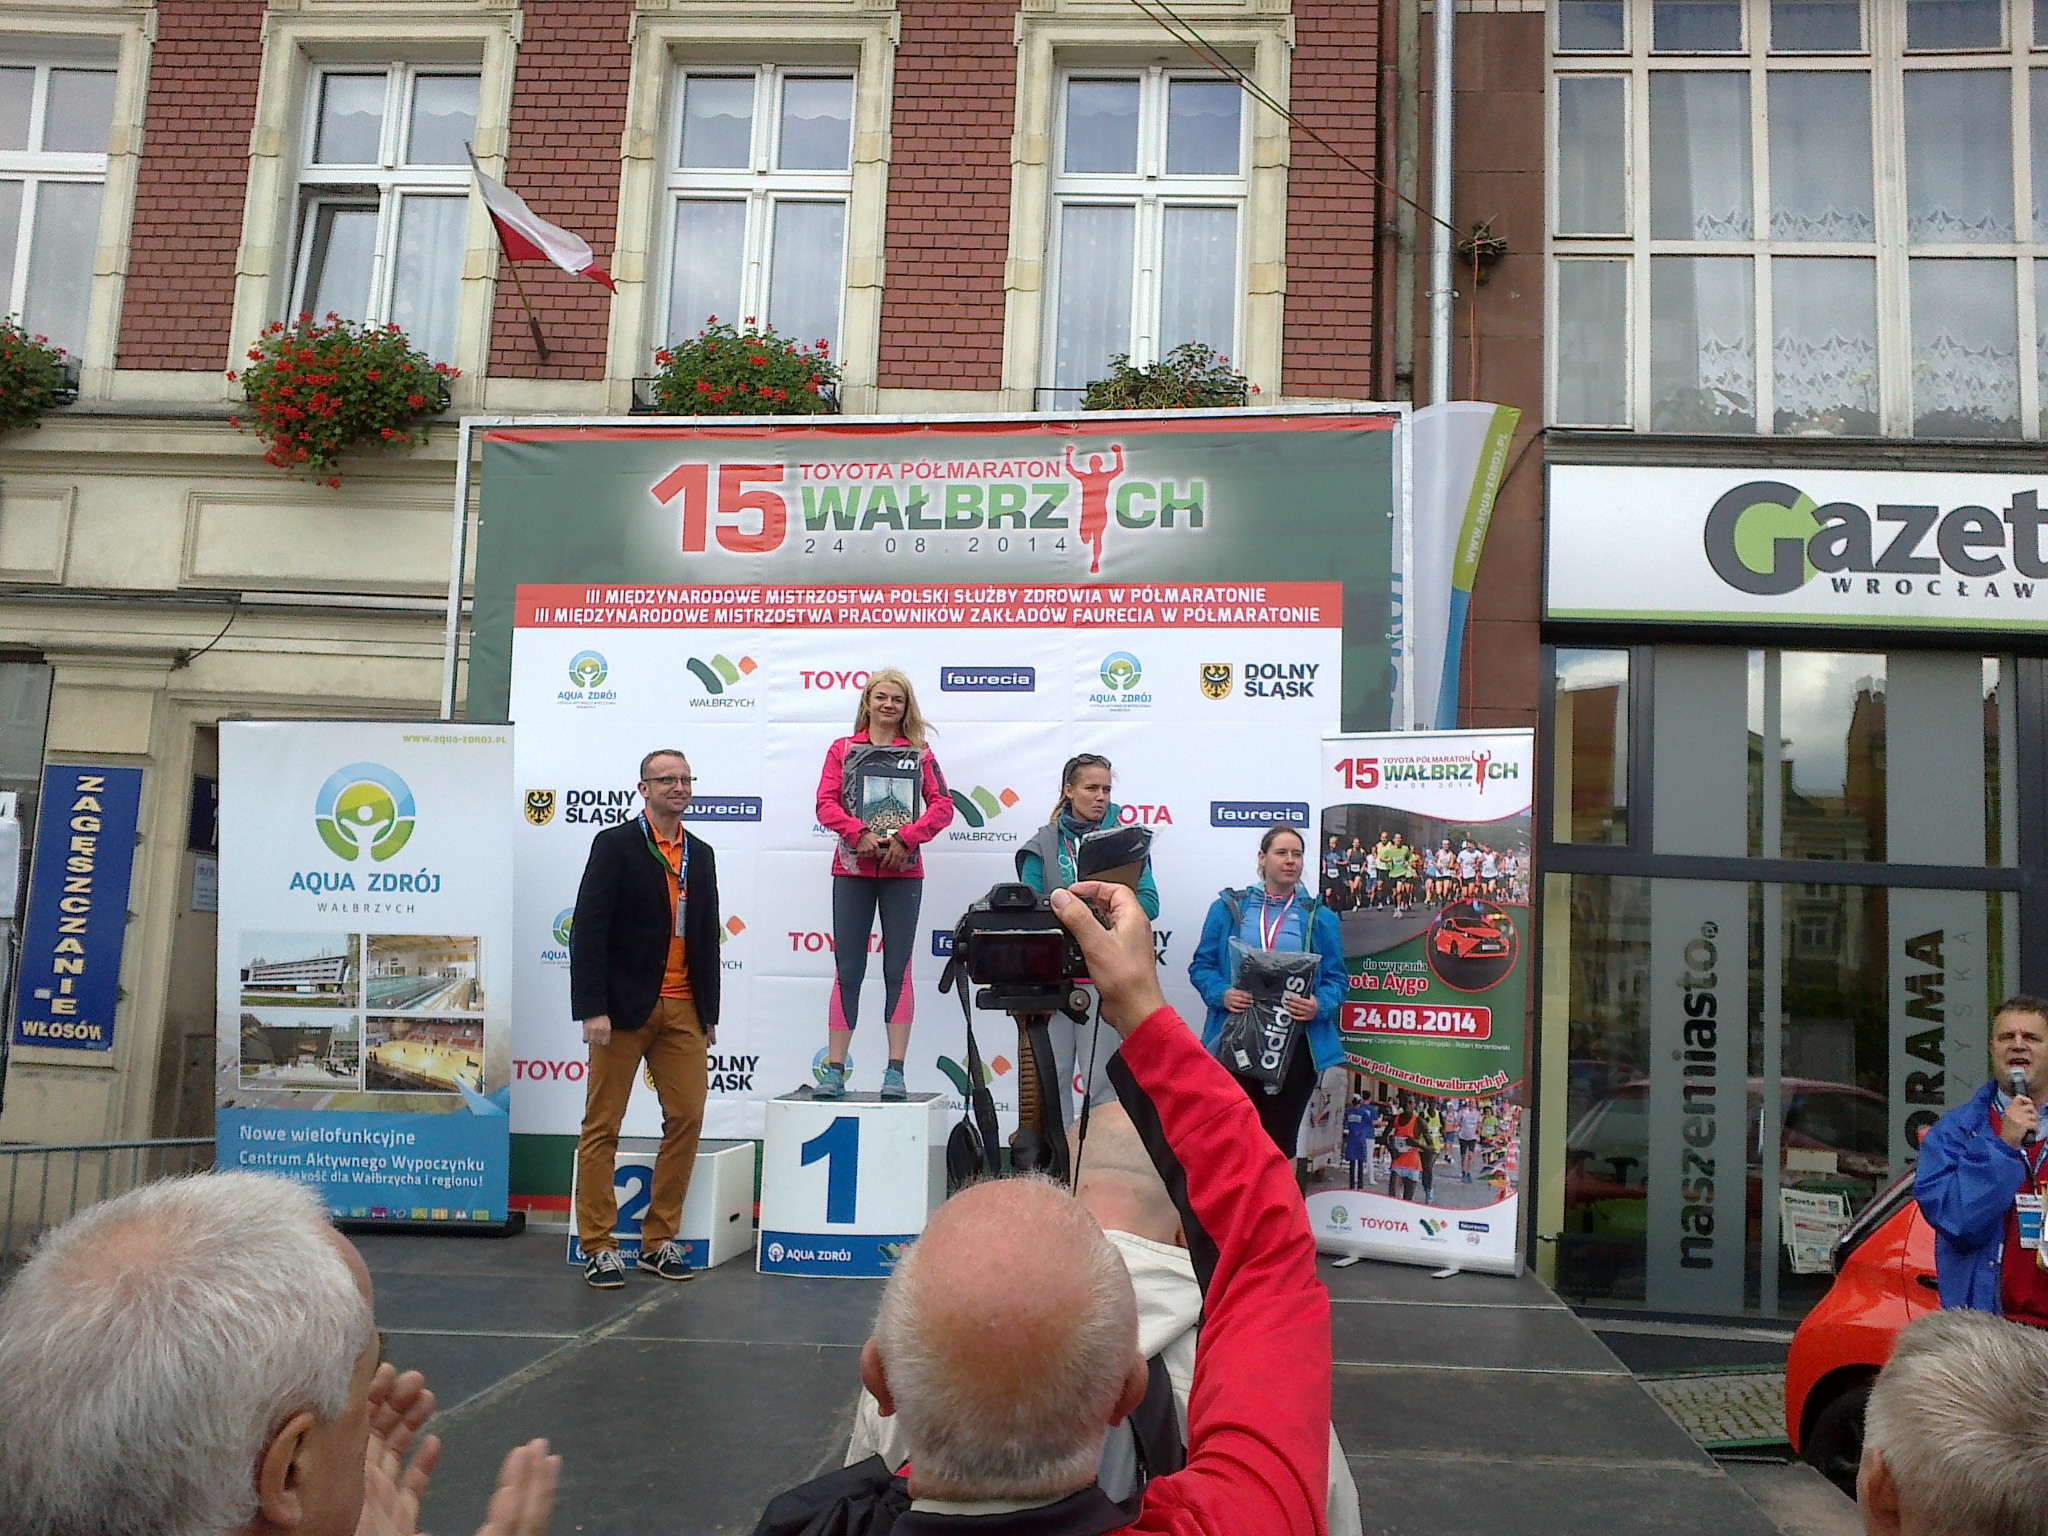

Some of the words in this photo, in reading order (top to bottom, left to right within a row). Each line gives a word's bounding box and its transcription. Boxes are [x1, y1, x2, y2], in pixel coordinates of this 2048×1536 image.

[800, 463, 893, 480] TOYOTA
[900, 459, 1061, 480] PÓŁMARATON
[650, 463, 787, 554] 15
[585, 589, 601, 604] III
[605, 589, 760, 608] MIĘDZYNARODOWE
[765, 589, 885, 604] MISTRZOSTWA
[889, 588, 950, 604] POLSKI
[953, 585, 1017, 604] SŁUŻBY
[1023, 588, 1102, 604] ZDROWIA
[1109, 588, 1125, 603] W
[1130, 584, 1267, 603] PÓŁMARATONIE
[1830, 576, 2035, 599] WROCŁAW
[534, 608, 550, 623] III
[553, 608, 709, 625] MIĘDZYNARODOWE
[713, 608, 834, 623] MISTRZOSTWA
[838, 604, 965, 623] PRACOWNIKÓW
[969, 604, 1068, 623] ZAKŁADÓW
[1072, 607, 1155, 623] FAURECIA
[1160, 607, 1177, 622] W
[1183, 603, 1321, 622] PÓŁMARATONIE
[799, 671, 873, 690] TOYO
[947, 672, 1031, 686] faurecia
[1244, 664, 1320, 680] DOLNY
[557, 692, 583, 702] AQUA
[587, 690, 617, 701] ZDRÓJ
[1089, 694, 1117, 703] AQUA
[1121, 692, 1152, 703] ZDRÓJ
[1244, 678, 1316, 700] ŚLĄSK
[689, 698, 755, 708] WAŁBRZYCH
[1334, 757, 1380, 790] 15
[566, 790, 637, 806] DOLNY
[683, 802, 758, 815] aurecia
[565, 804, 631, 826] ŚLĄSK
[1118, 804, 1174, 825] OTA
[1216, 808, 1305, 821] faurecia
[948, 832, 1018, 842] WAŁBRZYCH
[289, 871, 356, 895] AQUA
[367, 867, 441, 894] ZDRÓJ
[317, 902, 415, 914] WAŁBRZYCH
[788, 932, 884, 953] TOYT
[541, 951, 567, 962] AQUA
[1363, 958, 1378, 970] do
[1379, 960, 1428, 974] wygrania
[1347, 974, 1379, 991] ota
[1384, 973, 1429, 996] Aygo
[22, 1018, 102, 1041] WŁOSÓW
[1353, 1007, 1477, 1034] 24.08.2014
[1905, 929, 1945, 1164] ORAMA
[513, 1060, 590, 1082] TOYO
[707, 1055, 760, 1072] OLNY
[707, 1073, 754, 1094] ĄSK
[239, 1125, 287, 1142] Nowe
[291, 1126, 416, 1149] wielofunkcyjne
[239, 1150, 301, 1166] Centrum
[306, 1152, 388, 1173] Aktywnego
[392, 1155, 485, 1174] Wypoczynku
[800, 1116, 860, 1225] 1
[331, 1170, 349, 1183] dla
[352, 1171, 422, 1187] Wałbrzycha
[424, 1173, 429, 1185] i
[431, 1175, 484, 1190] regionu!
[613, 1164, 654, 1235] 2
[1360, 1217, 1410, 1233] TOYOTA
[616, 1248, 640, 1260] ZDRÓ
[786, 1249, 815, 1262] AQUA
[817, 1246, 852, 1262] ZDRÓJ
